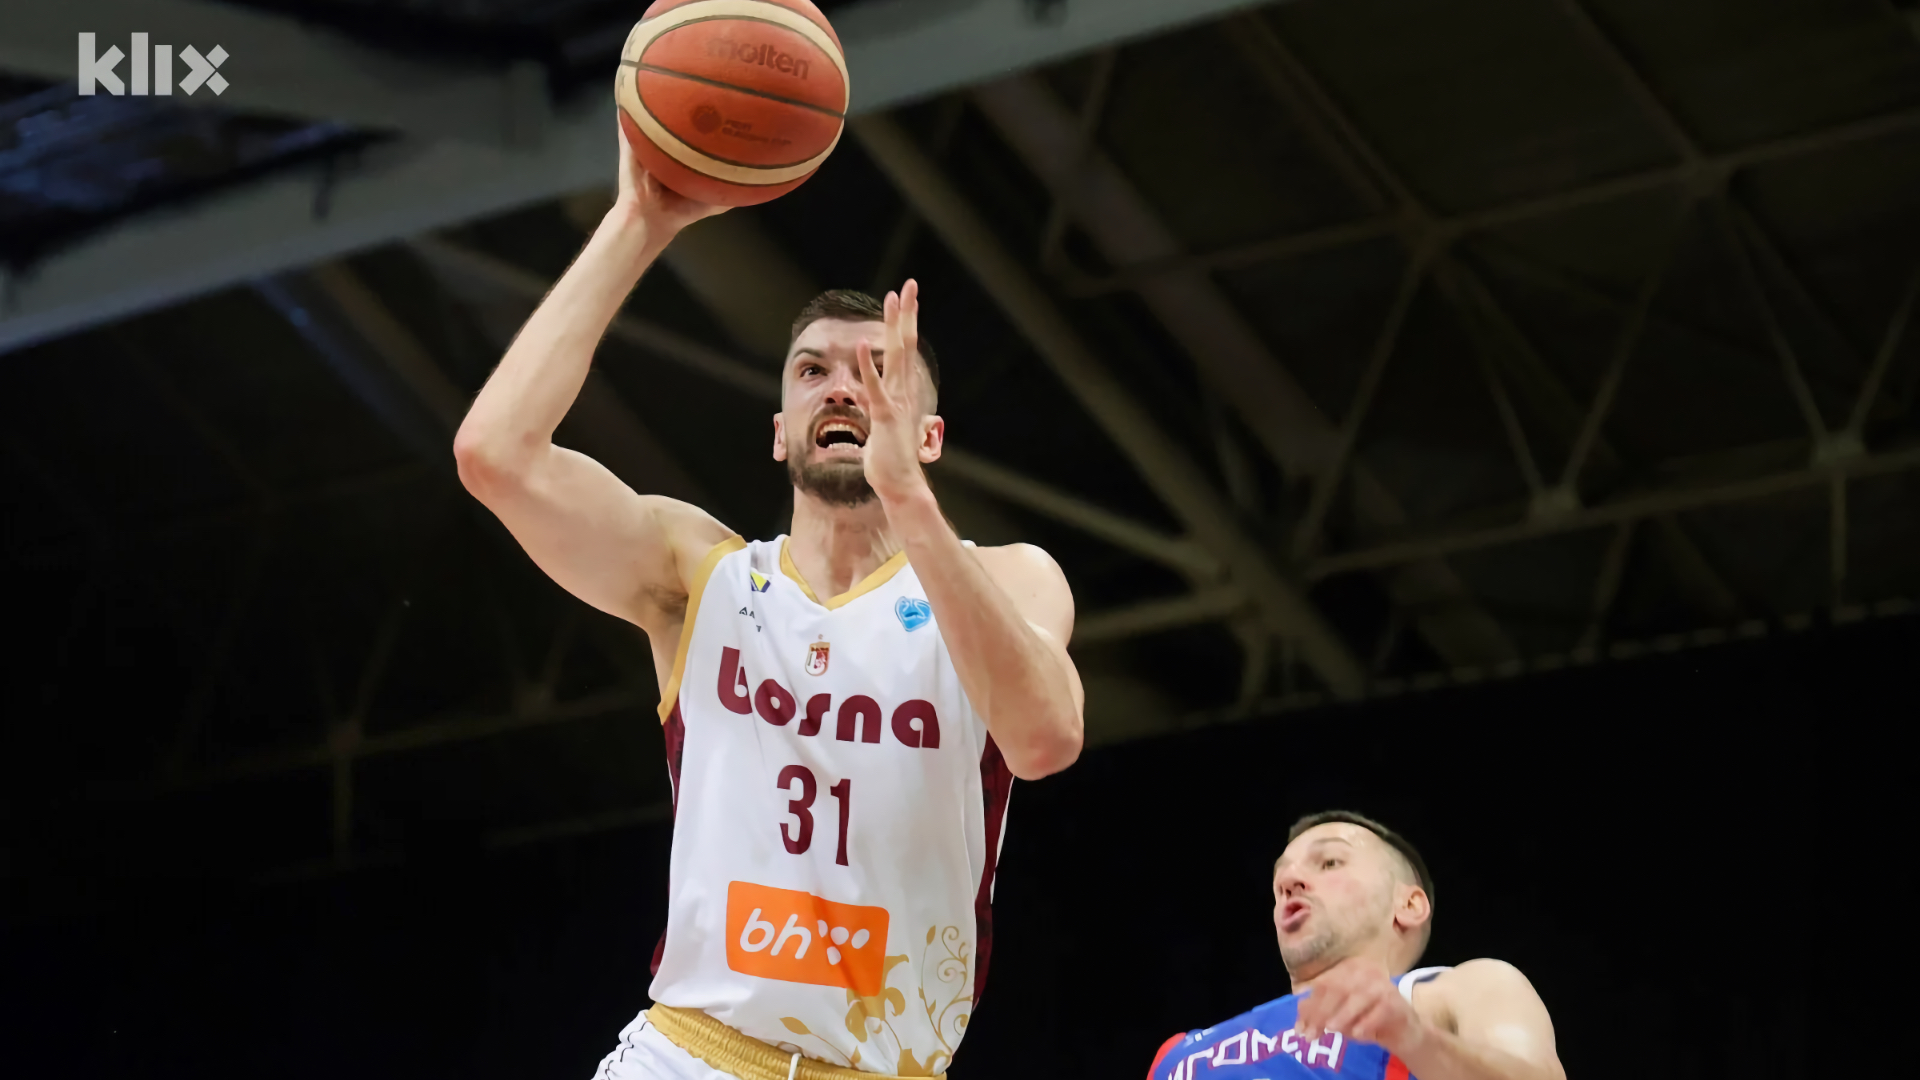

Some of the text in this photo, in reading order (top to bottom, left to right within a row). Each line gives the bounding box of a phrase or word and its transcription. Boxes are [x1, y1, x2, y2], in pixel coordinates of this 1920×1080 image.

[707, 38, 809, 80] molten
[717, 646, 940, 749] bosna
[777, 765, 851, 866] 31
[740, 908, 811, 960] bh
